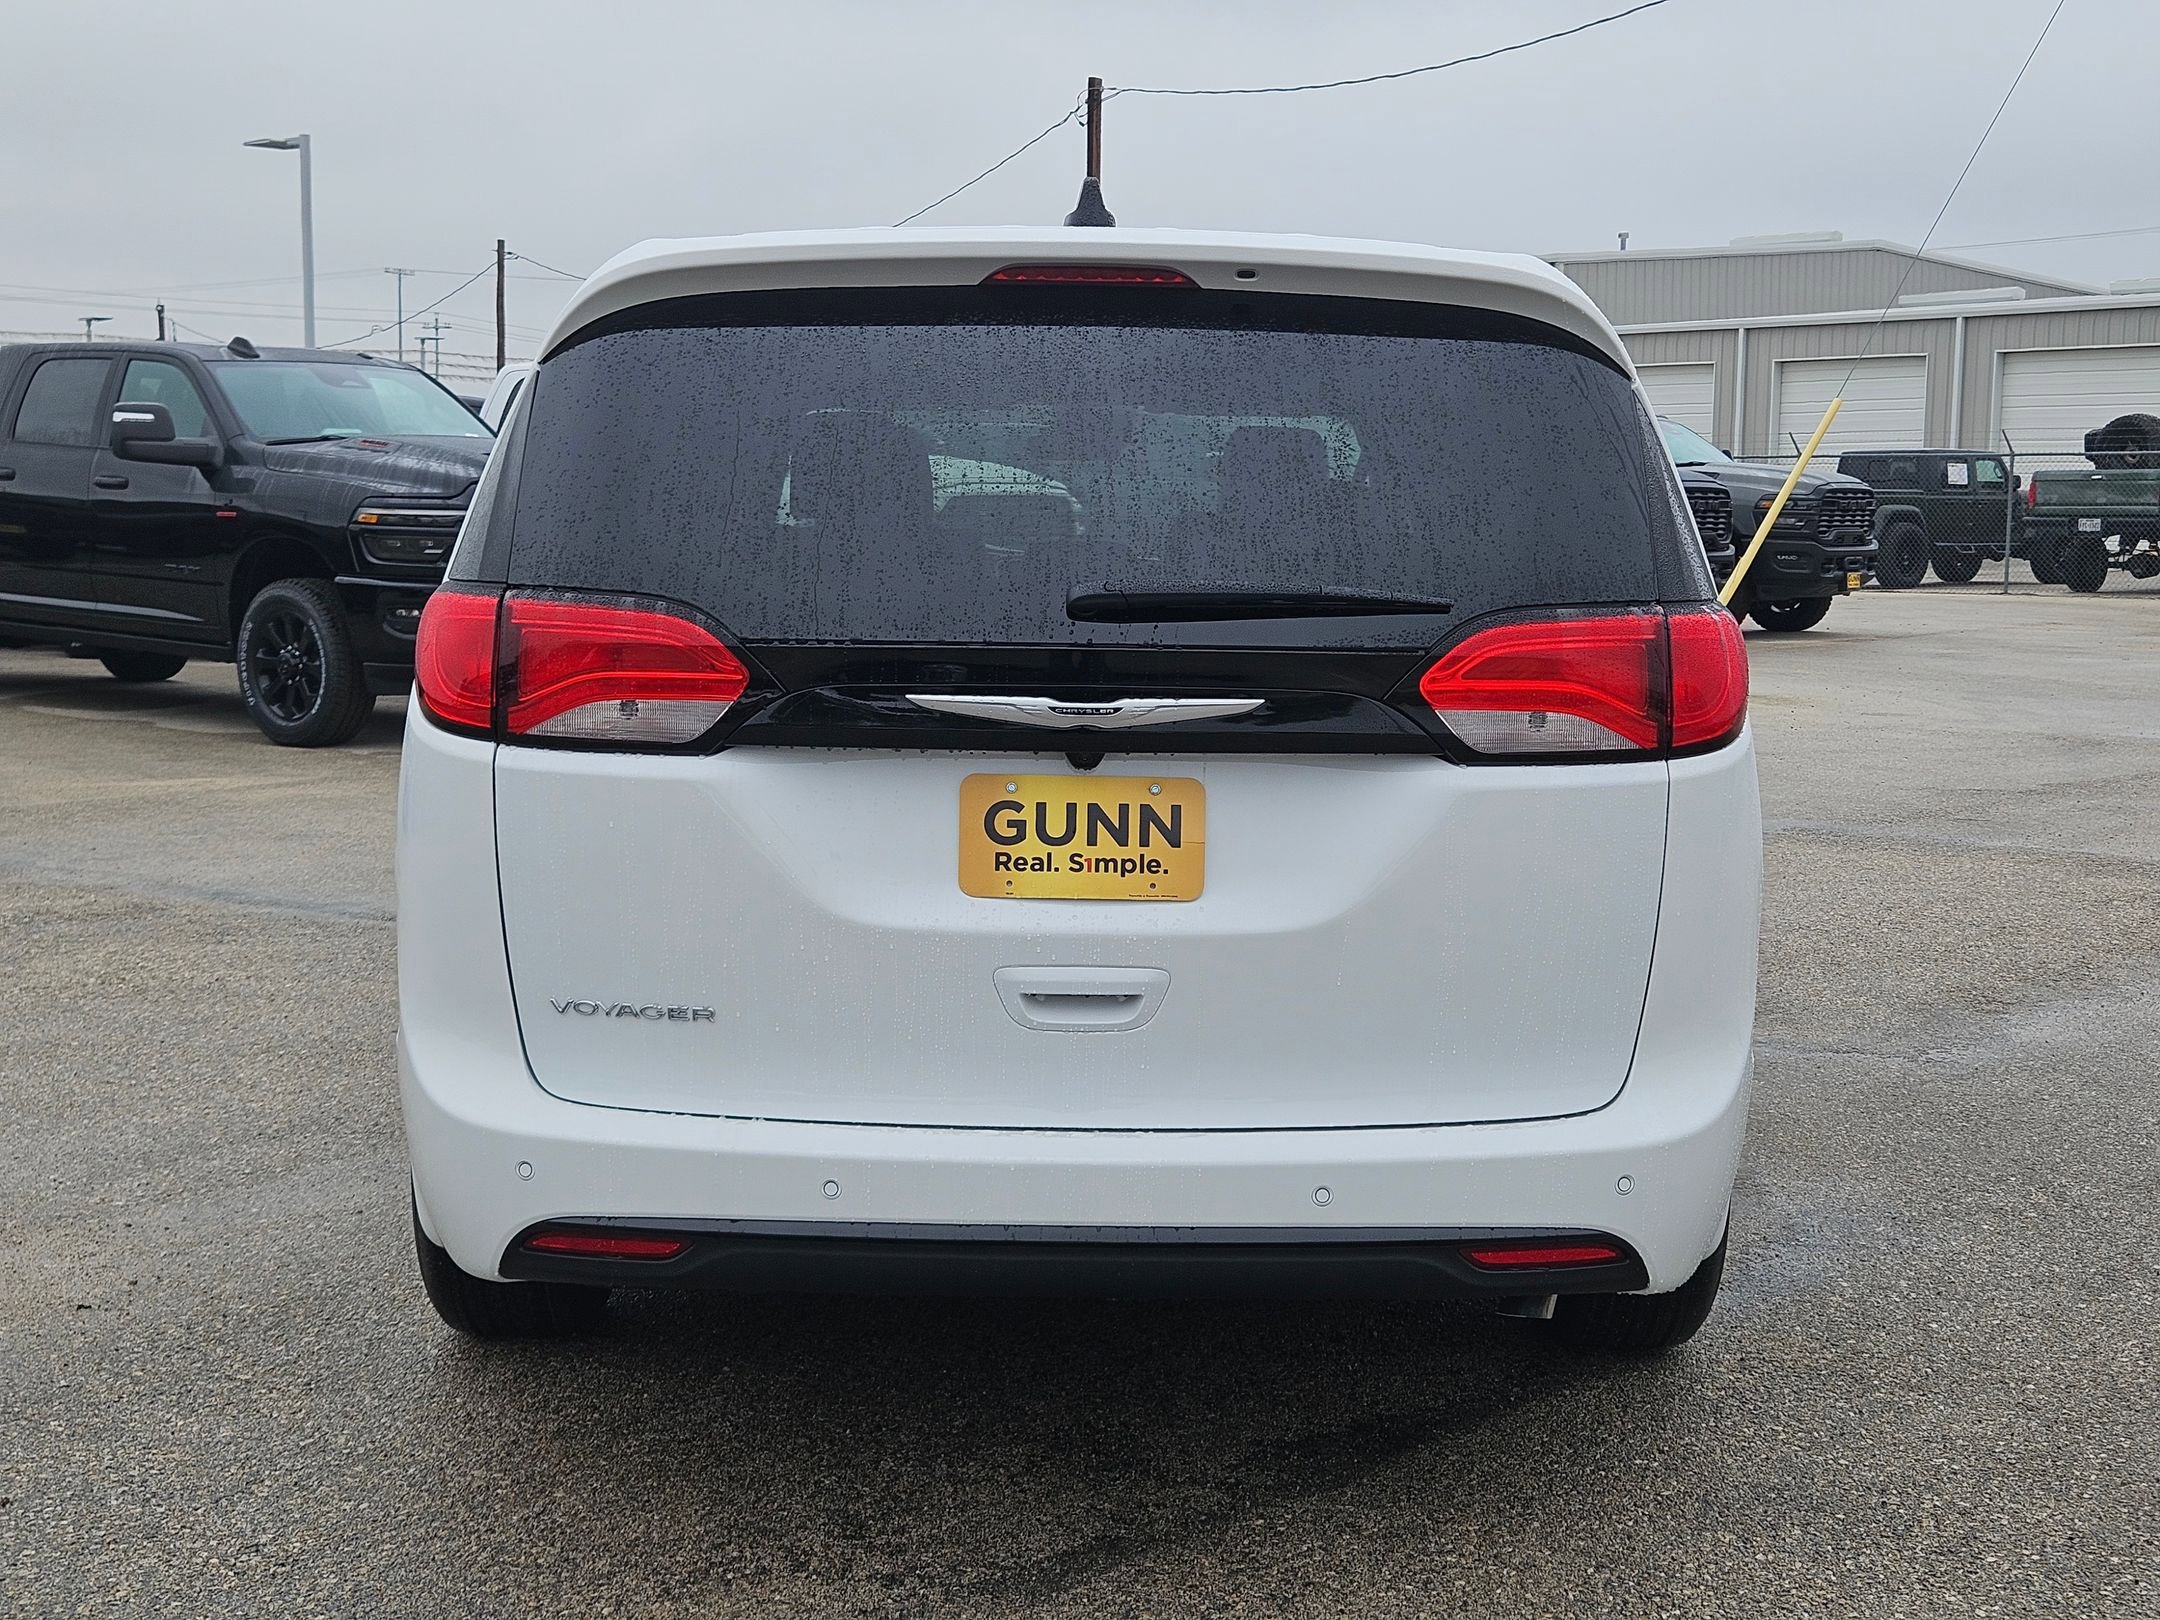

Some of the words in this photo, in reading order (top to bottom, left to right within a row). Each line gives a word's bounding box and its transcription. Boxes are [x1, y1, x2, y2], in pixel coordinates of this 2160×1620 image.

[984, 800, 1182, 848] GUNN
[994, 851, 1060, 873] Real.
[550, 998, 717, 1023] VOYAGER
